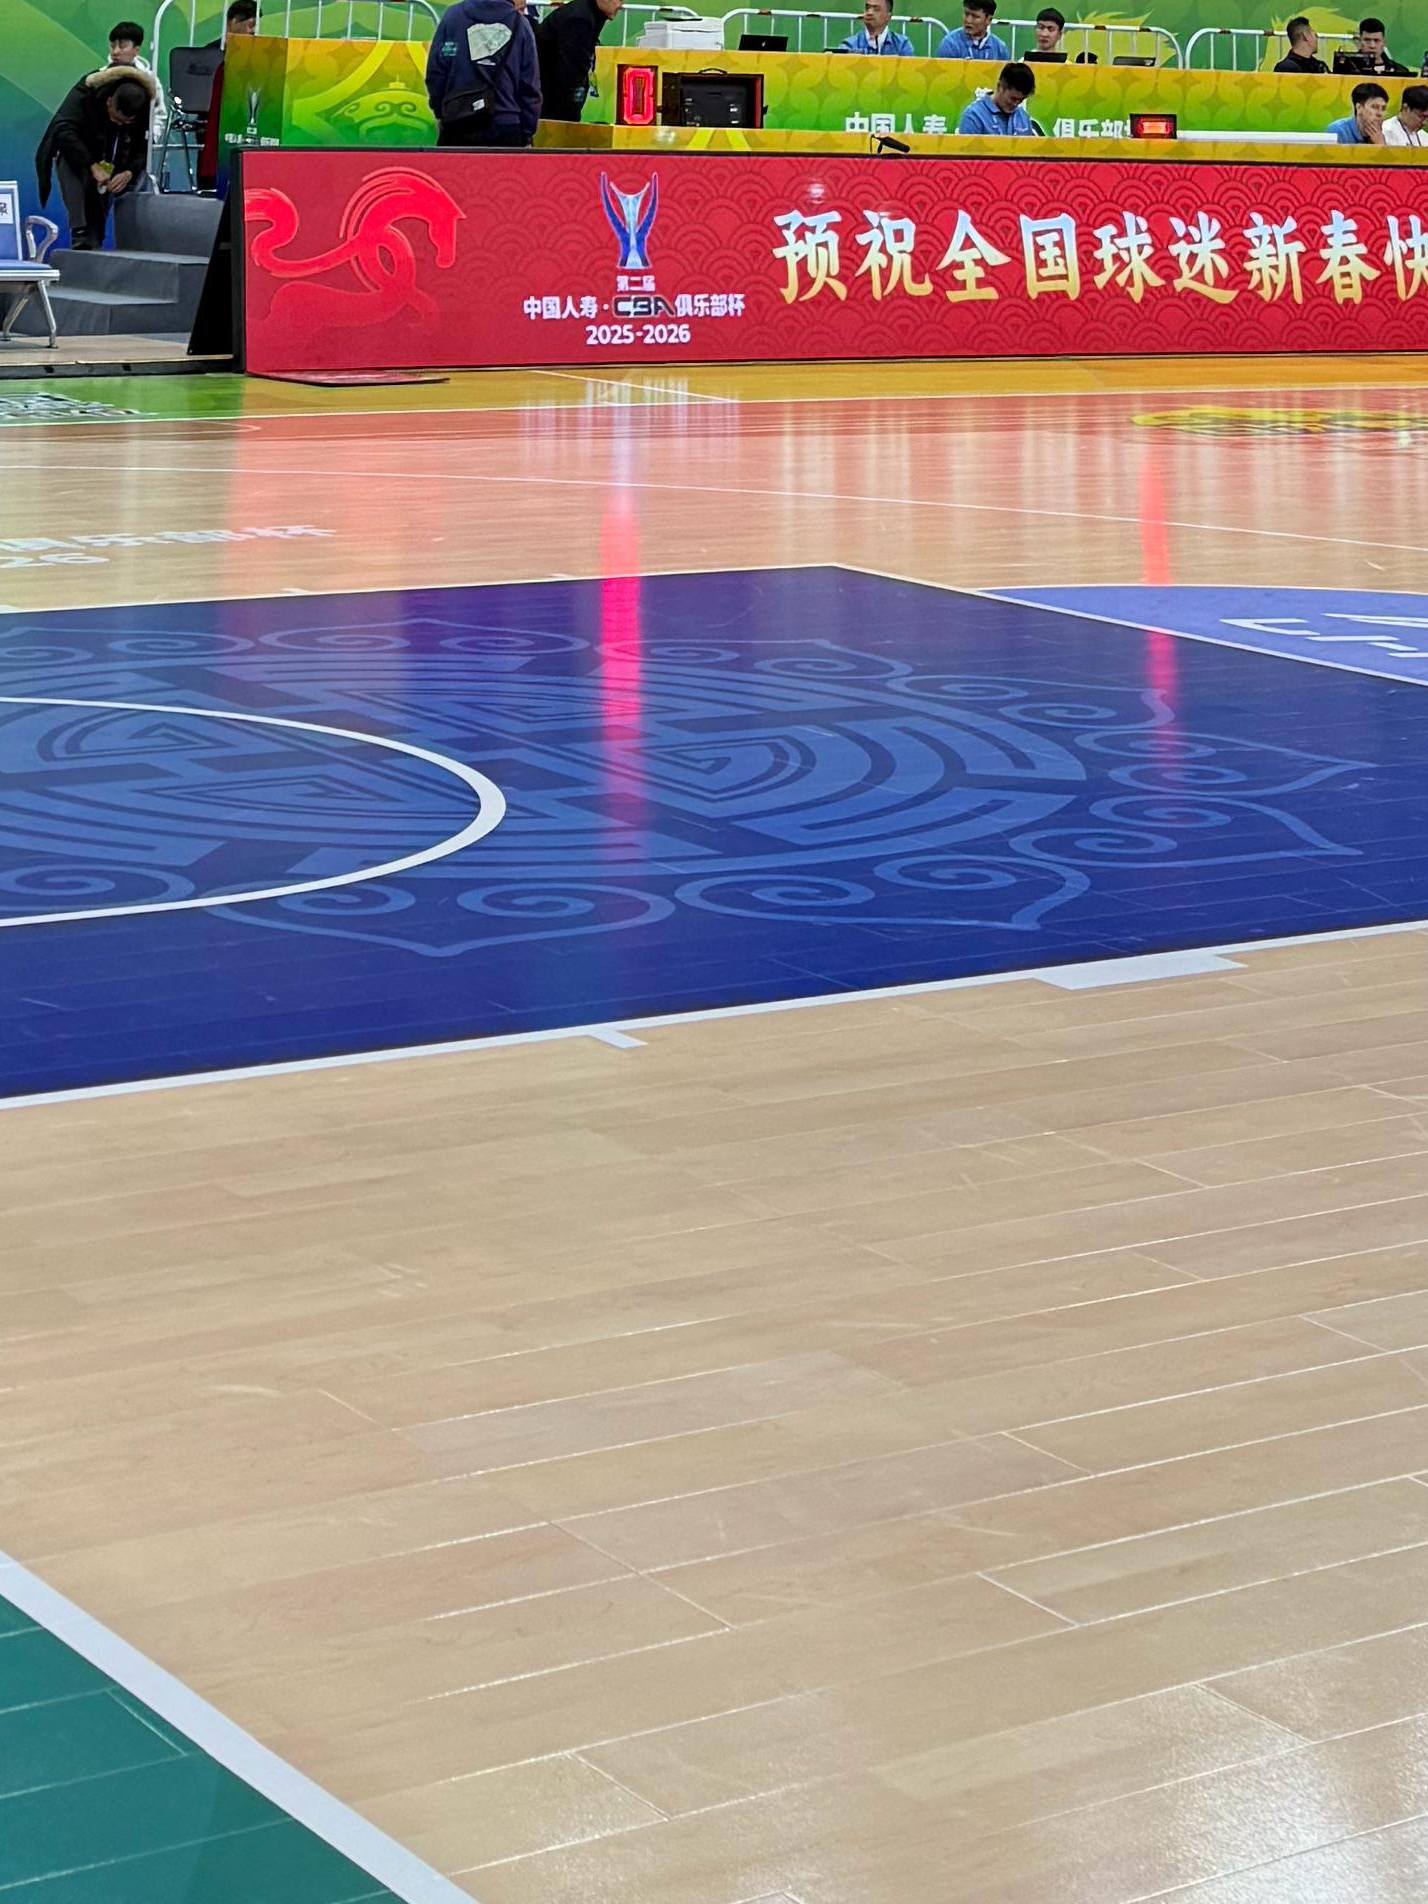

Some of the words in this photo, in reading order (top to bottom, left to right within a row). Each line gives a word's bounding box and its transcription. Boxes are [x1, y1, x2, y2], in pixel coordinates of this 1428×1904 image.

[617, 275, 655, 294] 第二届
[586, 323, 691, 347] 2025-2026
